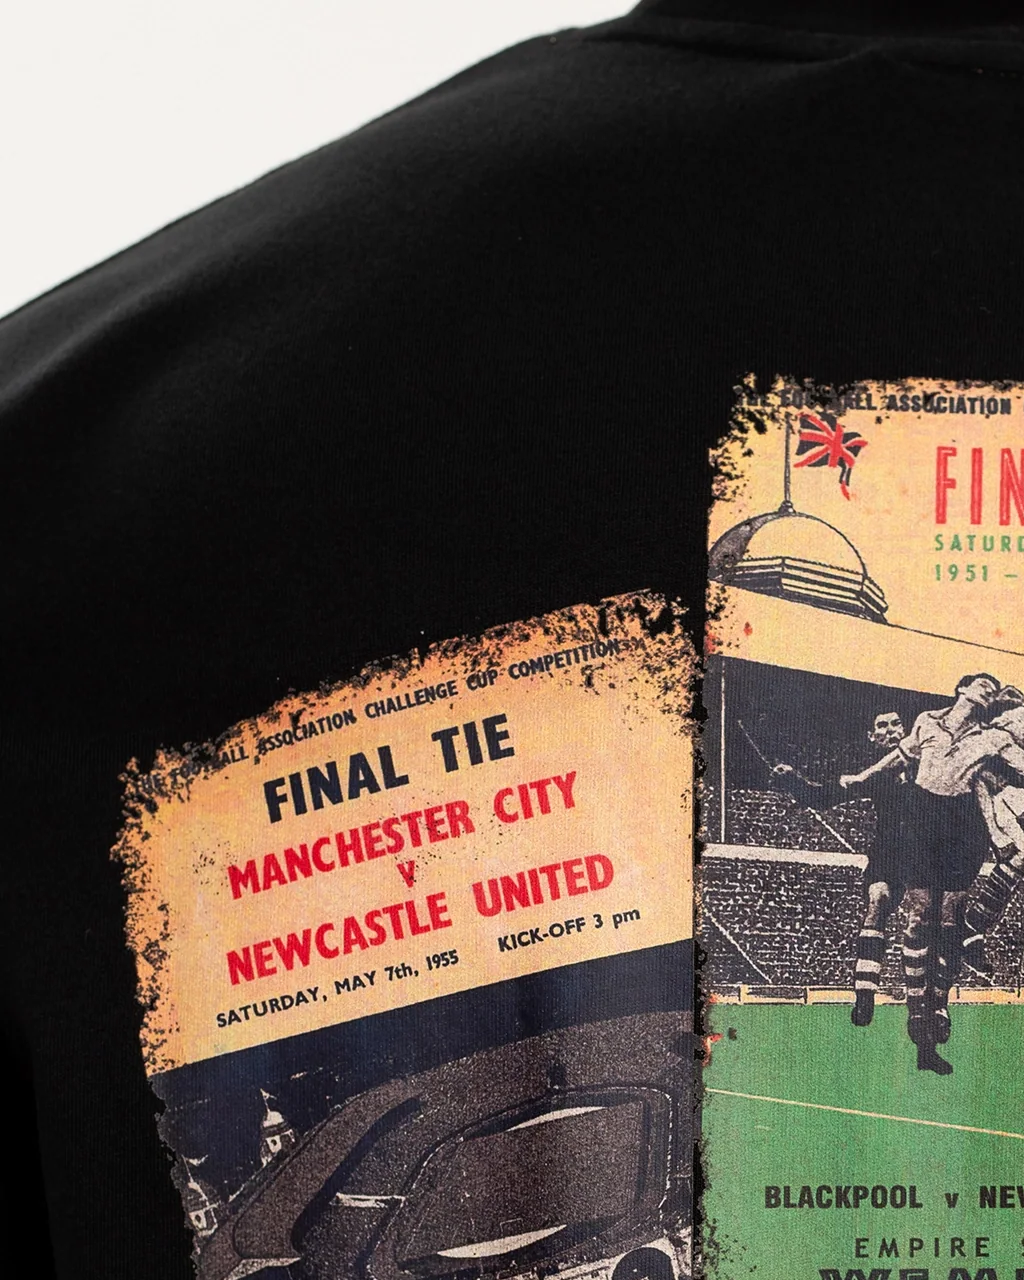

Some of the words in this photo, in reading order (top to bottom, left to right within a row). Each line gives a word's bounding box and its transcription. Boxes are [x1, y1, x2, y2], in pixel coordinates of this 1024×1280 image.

[886, 393, 1012, 415] ASSOCIATION
[935, 564, 990, 583] 1951
[257, 709, 358, 754] ASSOCIATION
[364, 680, 458, 719] CHALLENGE
[466, 669, 498, 691] CUP
[508, 638, 620, 680] COMPETITION
[263, 745, 409, 823] FINAL
[431, 713, 515, 773] TIE
[227, 800, 475, 900] MANCHESTER
[493, 771, 577, 825] CITY
[226, 892, 452, 986] NEWCASTLE
[472, 854, 614, 917] UNITED
[497, 917, 586, 952] KICK-OFF
[593, 913, 604, 929] 3
[612, 909, 641, 929] pm
[216, 987, 328, 1028] SATURDAY,
[334, 970, 376, 995] MAY
[384, 962, 419, 982] 7th,
[426, 949, 459, 971] 1955
[764, 1185, 923, 1210] BLACKPOOL
[855, 1238, 990, 1259] EMPIRE
